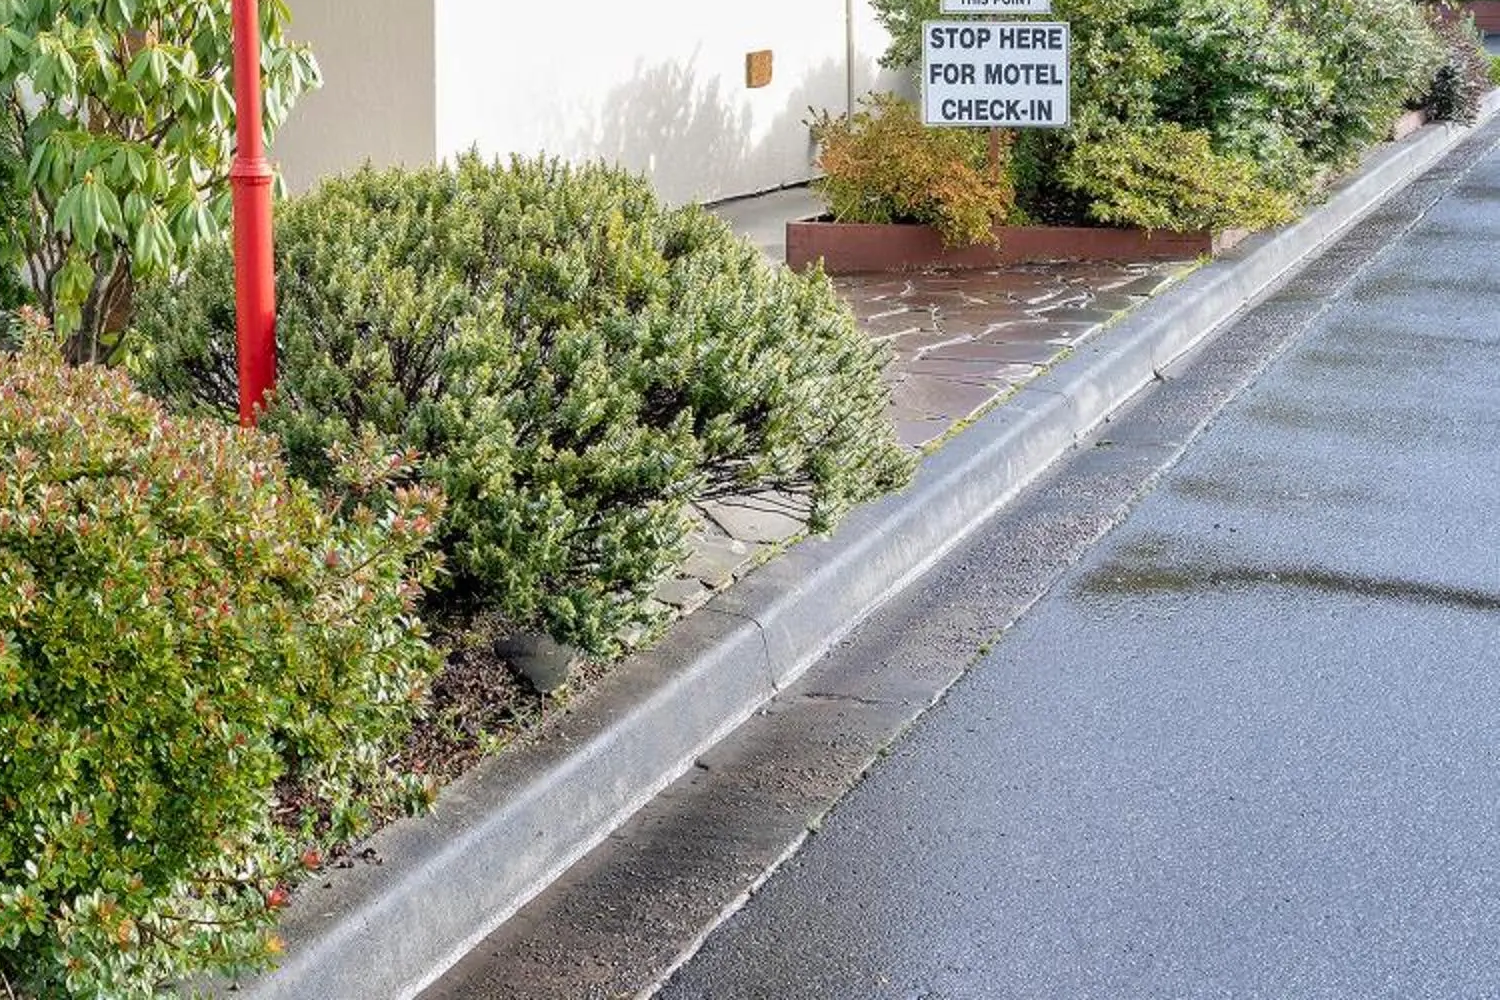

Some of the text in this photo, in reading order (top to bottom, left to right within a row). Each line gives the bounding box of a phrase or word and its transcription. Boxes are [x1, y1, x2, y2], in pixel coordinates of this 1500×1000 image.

[930, 28, 1062, 49] STOP HERE
[930, 64, 1062, 85] FOR MOTEL
[941, 100, 1052, 120] CHECK-IN
